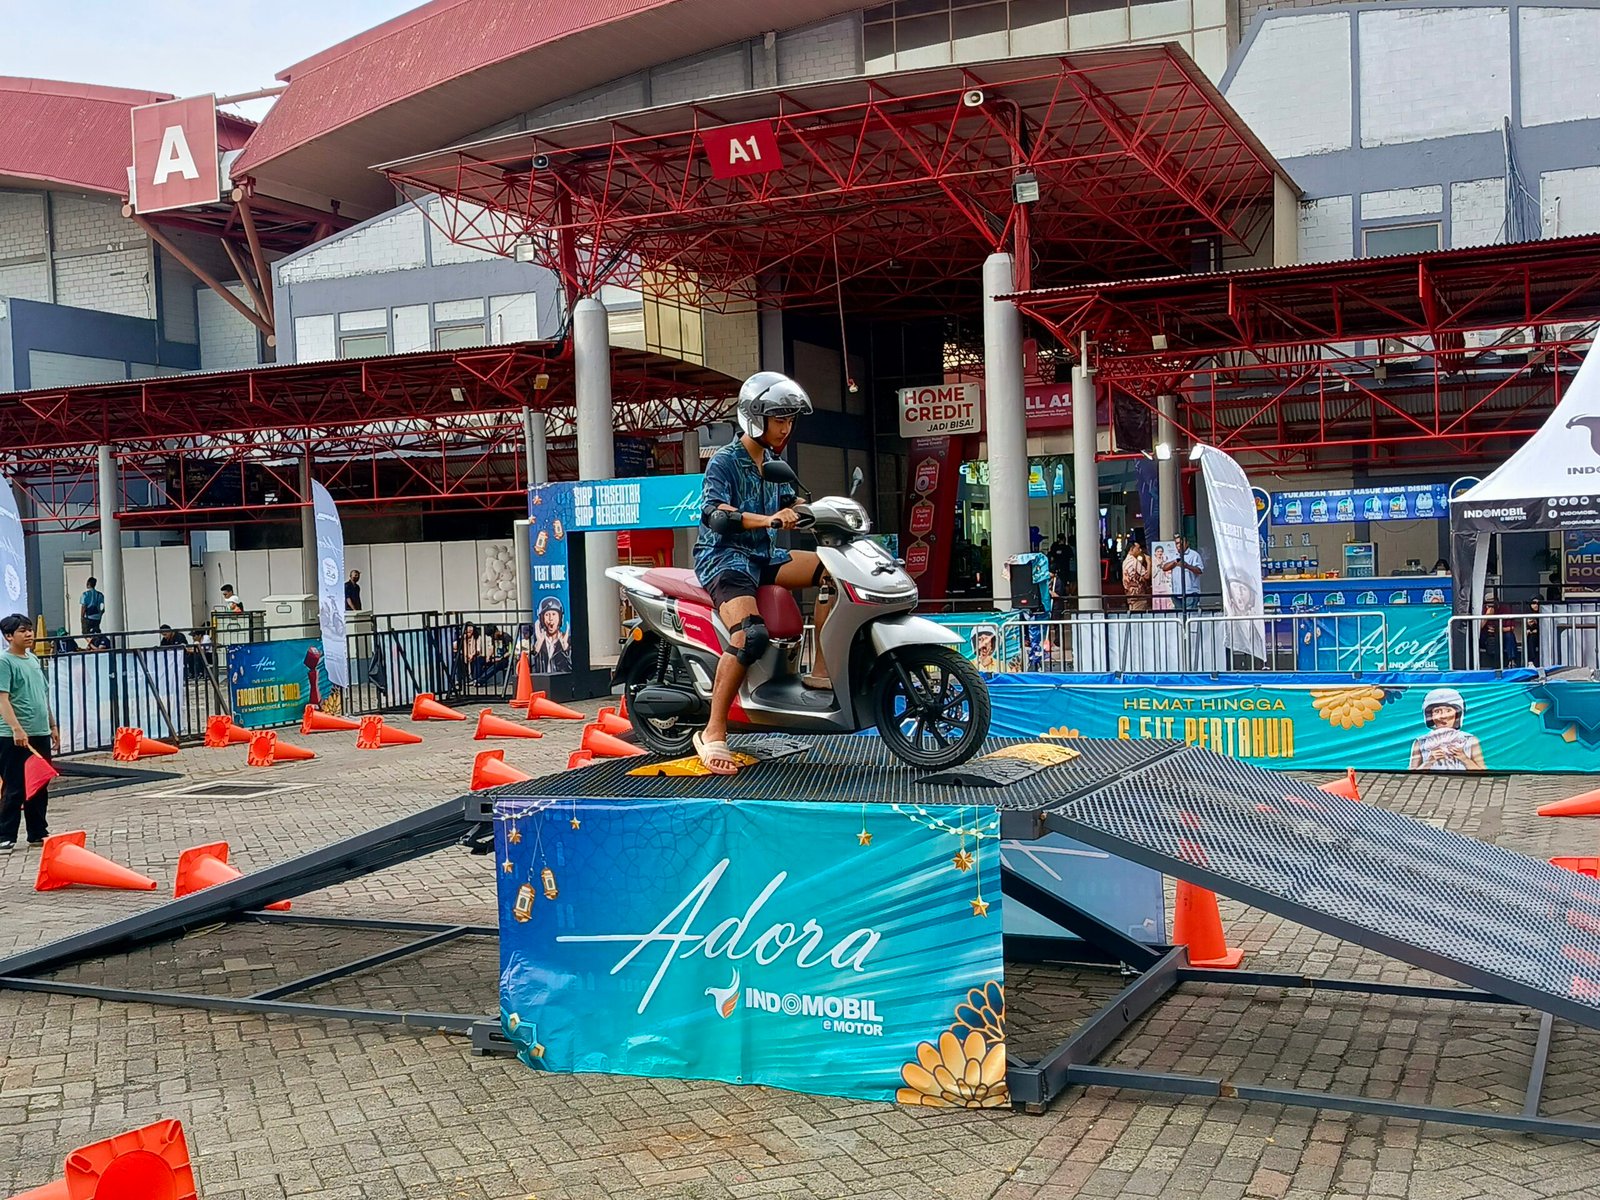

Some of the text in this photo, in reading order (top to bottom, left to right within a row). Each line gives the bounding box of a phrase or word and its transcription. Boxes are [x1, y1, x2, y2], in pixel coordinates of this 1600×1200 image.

[153, 125, 200, 186] A
[729, 135, 762, 165] A1
[904, 386, 965, 405] HOME
[1025, 393, 1072, 410] LL A1
[905, 403, 974, 423] CREDIT
[927, 418, 975, 432] JADI BISA!
[573, 483, 641, 507] SIAP TERSENTAK
[1283, 490, 1327, 499] TUKARKAN
[1383, 486, 1406, 494] ANDA
[1407, 485, 1433, 493] DISINI
[575, 503, 640, 527] SIAP BERGERAK!
[1463, 507, 1527, 519] INDOMOBIL
[533, 565, 550, 582] TEST
[1124, 698, 1286, 711] HEMAT HINGGA
[556, 858, 881, 1015] Adora
[745, 987, 884, 1023] INDOMOBIL
[834, 1020, 884, 1037] MOTOR
